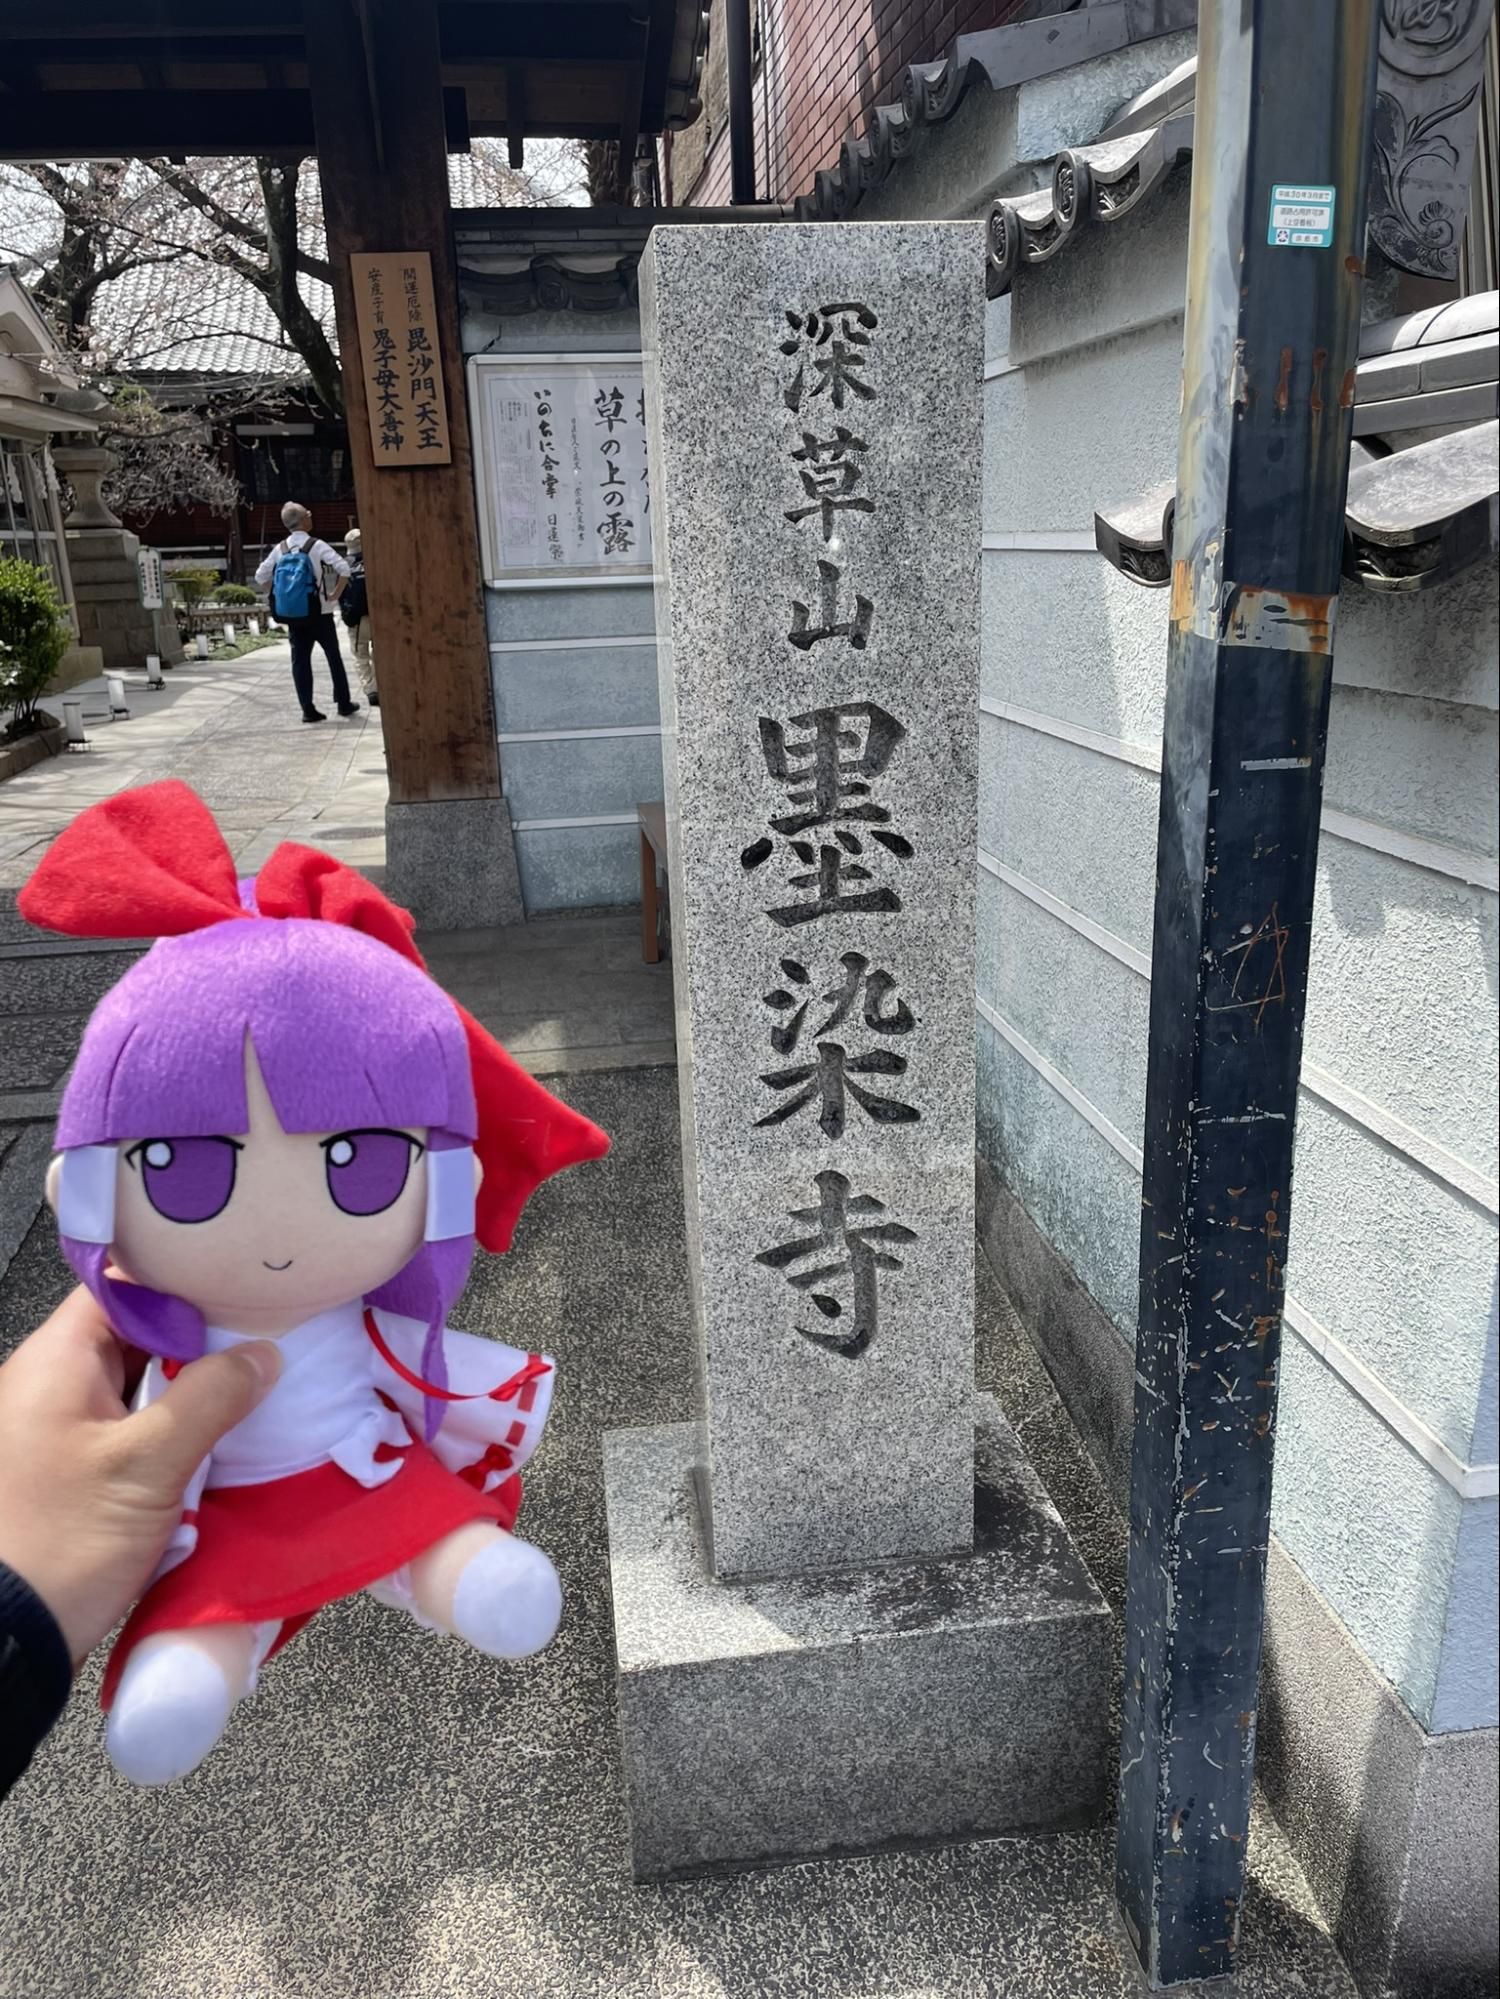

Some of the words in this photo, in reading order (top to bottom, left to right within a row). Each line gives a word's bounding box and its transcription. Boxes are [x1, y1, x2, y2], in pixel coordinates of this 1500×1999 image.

[534, 388, 561, 500] いのちに合掌
[594, 385, 637, 556] 草の上の露
[741, 302, 921, 1360] 深草山墨染寺
